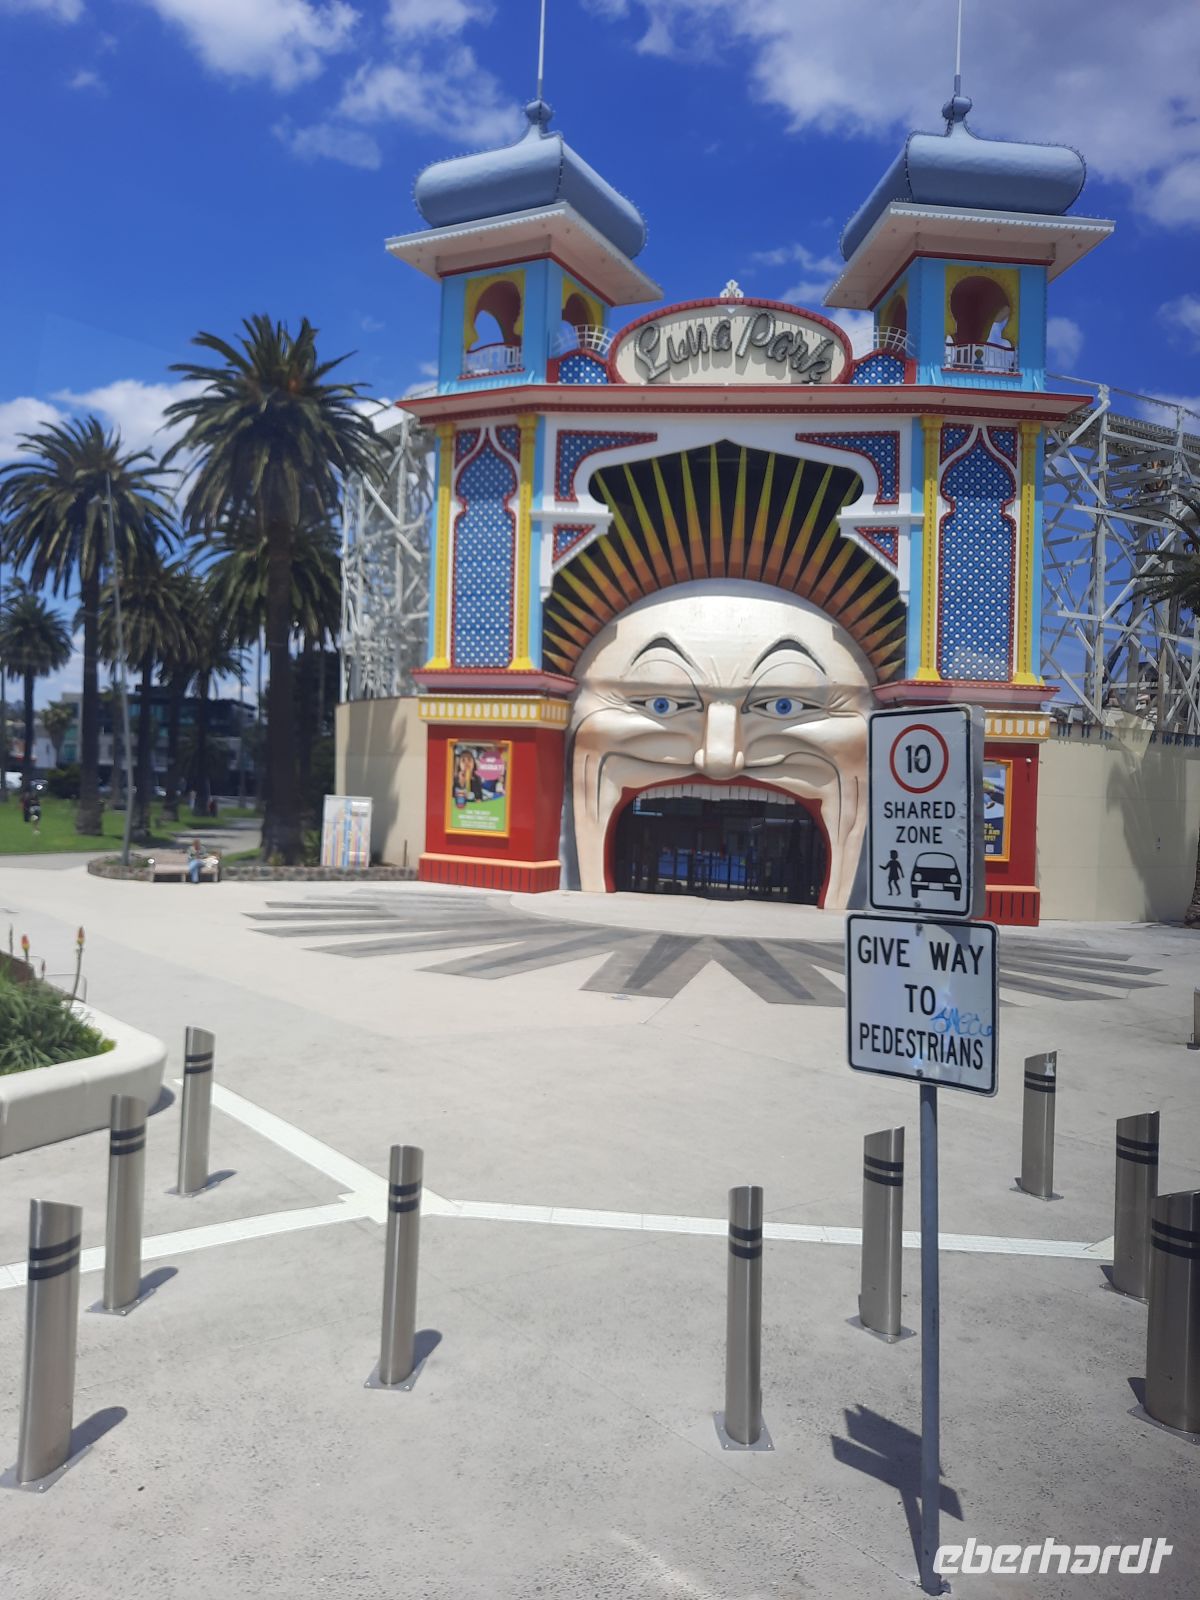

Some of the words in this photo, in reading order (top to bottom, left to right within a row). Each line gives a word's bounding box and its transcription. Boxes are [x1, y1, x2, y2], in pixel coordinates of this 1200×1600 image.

[635, 321, 733, 382] Luna
[736, 310, 834, 384] Park
[905, 744, 932, 774] 10
[883, 801, 956, 819] SHARED
[895, 825, 944, 844] ZONE
[857, 934, 911, 968] GIVE
[929, 940, 984, 976] WAY
[904, 983, 937, 1016] TO
[859, 1022, 984, 1070] PEDESTRIANS
